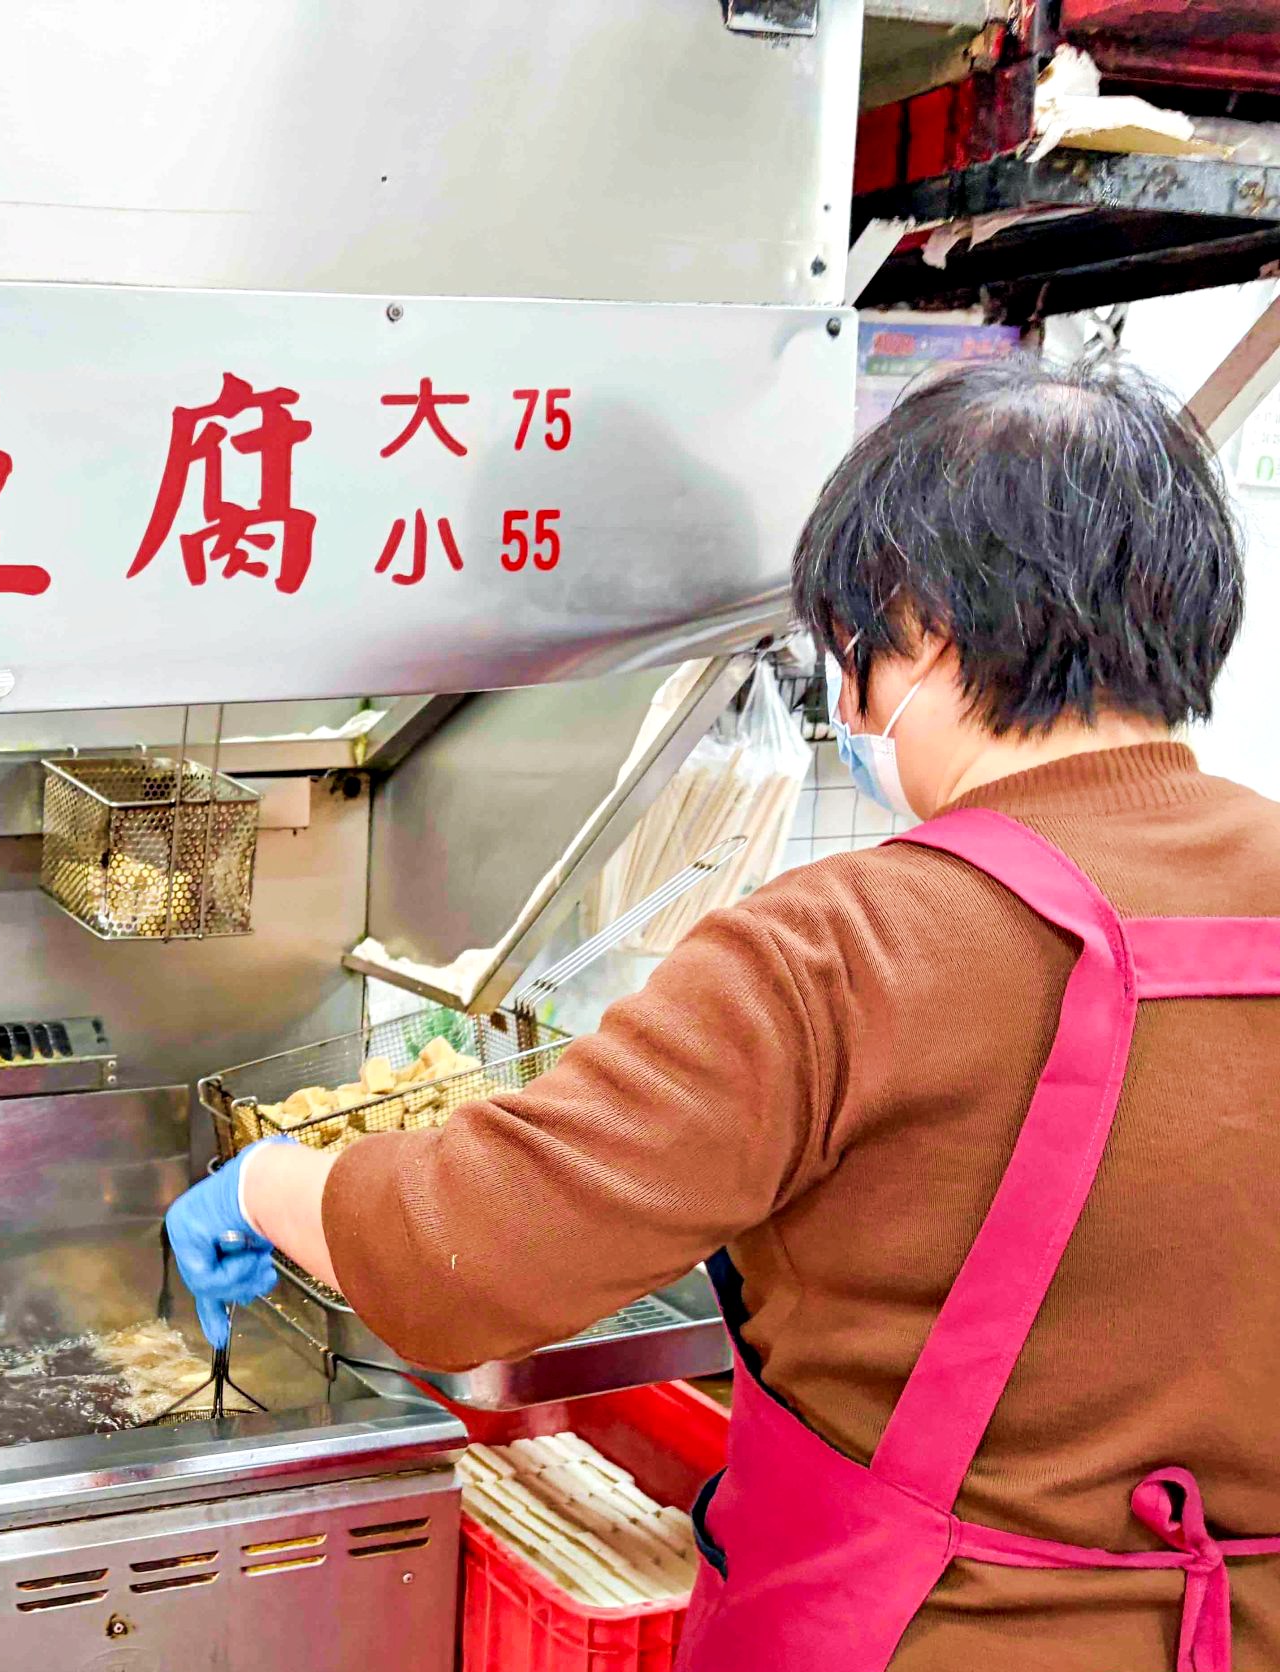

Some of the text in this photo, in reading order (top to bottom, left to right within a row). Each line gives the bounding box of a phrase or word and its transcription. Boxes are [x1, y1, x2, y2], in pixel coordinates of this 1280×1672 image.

[379, 376, 572, 458] 大 75
[374, 507, 561, 586] 小 55
